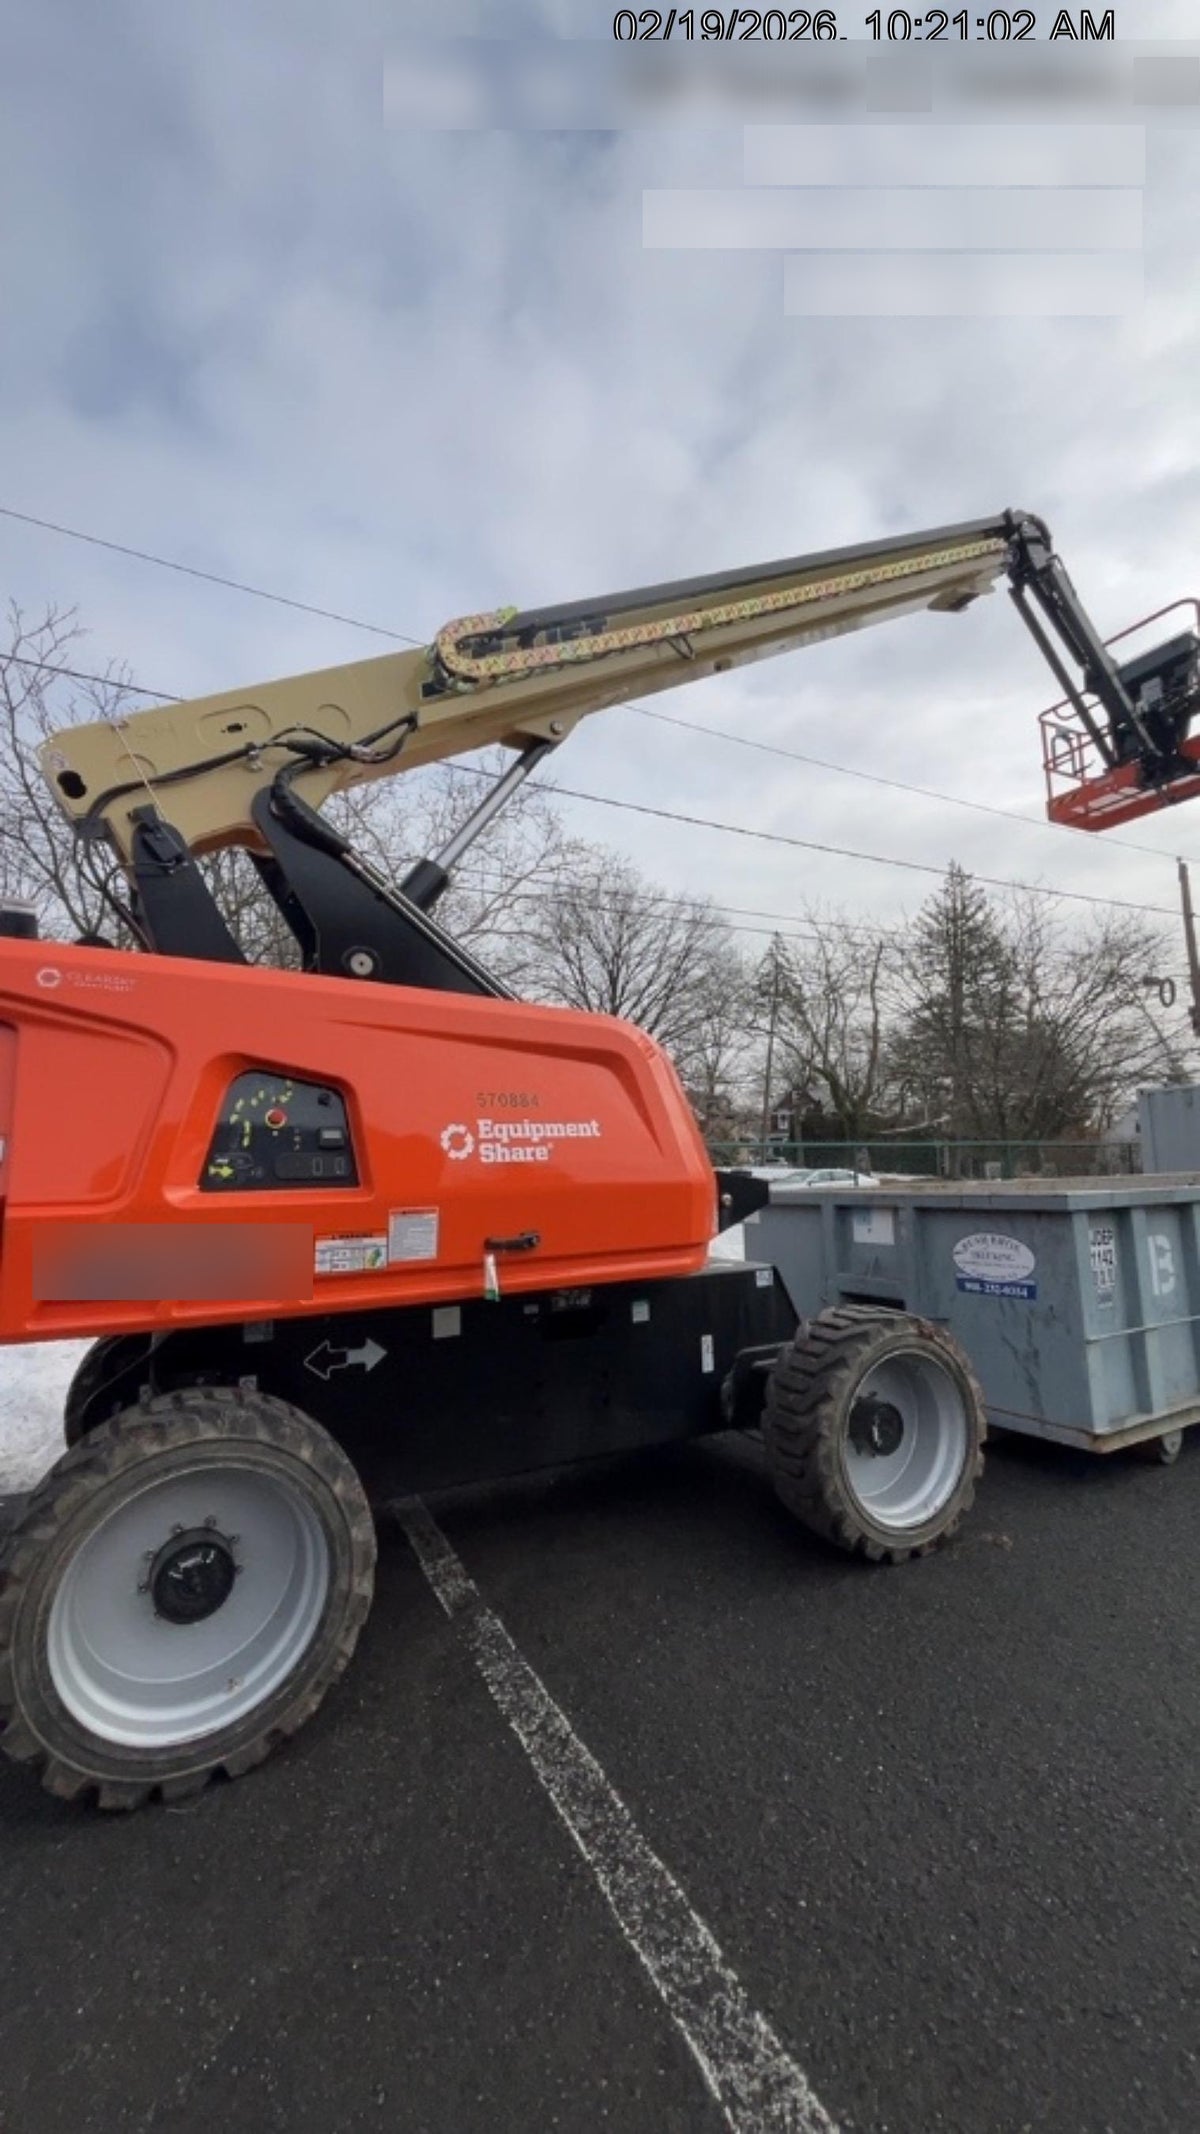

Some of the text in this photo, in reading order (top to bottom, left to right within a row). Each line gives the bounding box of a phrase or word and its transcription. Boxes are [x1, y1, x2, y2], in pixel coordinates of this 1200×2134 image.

[476, 1092, 540, 1108] 570884
[477, 1118, 602, 1143] Equipment
[478, 1142, 549, 1163] Share
[1146, 1234, 1175, 1296] B
